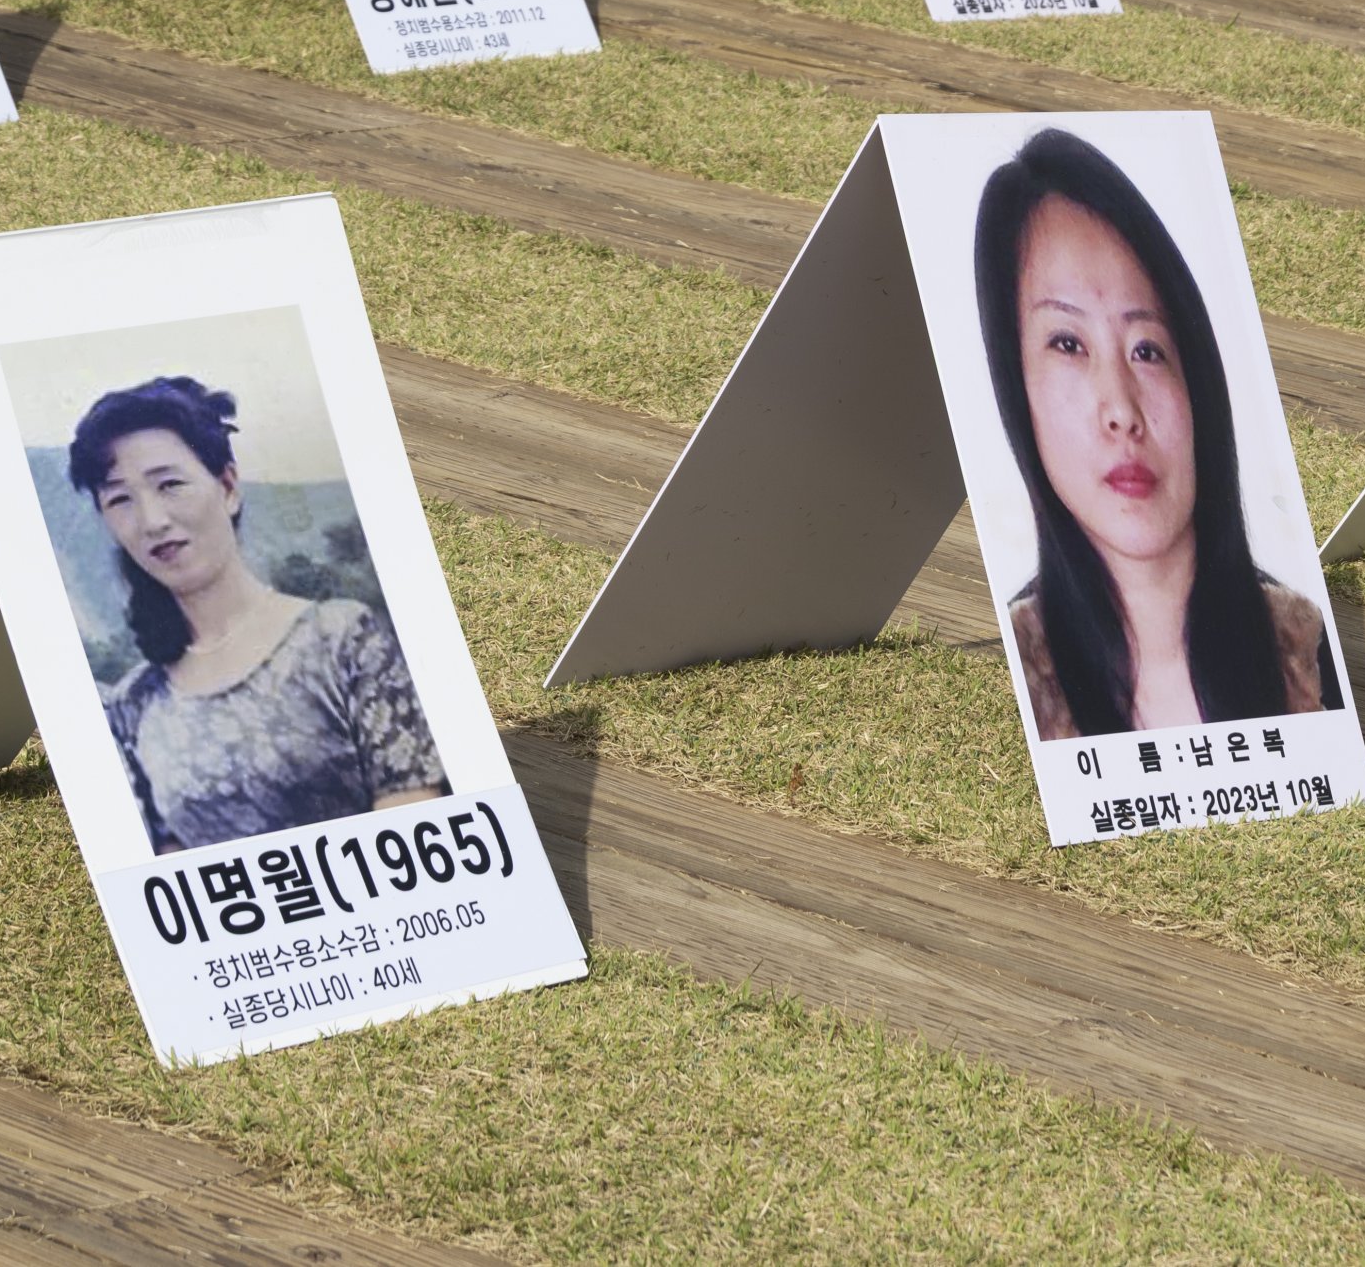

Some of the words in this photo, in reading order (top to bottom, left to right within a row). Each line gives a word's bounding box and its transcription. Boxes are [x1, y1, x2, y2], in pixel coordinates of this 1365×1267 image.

[395, 13, 488, 35] 정치범수용소수감
[496, 7, 545, 23] 2011.12
[404, 37, 473, 58] 실종당시나이
[483, 34, 510, 49] 43세
[1077, 748, 1101, 779] 이
[1139, 741, 1162, 773] 름
[1091, 793, 1181, 833] 실종일자
[1203, 780, 1280, 816] 2023년
[1287, 775, 1334, 806] 10월
[144, 802, 514, 945] 이명월(1965)
[205, 924, 382, 989] 정치범수용소수감
[396, 901, 485, 942] 2006.05
[223, 976, 354, 1029] 실종당시나이
[373, 956, 422, 992] 40세
